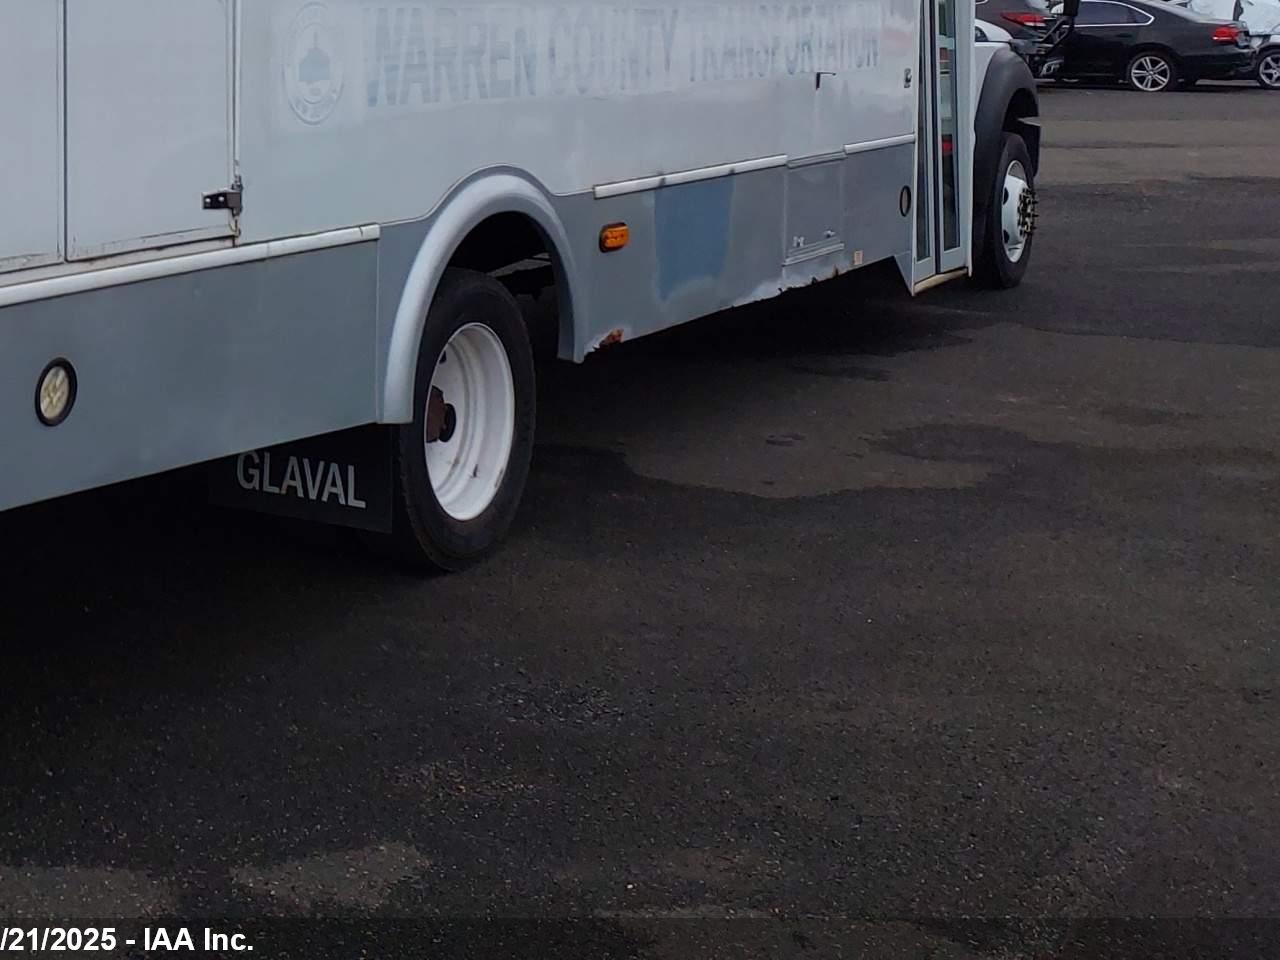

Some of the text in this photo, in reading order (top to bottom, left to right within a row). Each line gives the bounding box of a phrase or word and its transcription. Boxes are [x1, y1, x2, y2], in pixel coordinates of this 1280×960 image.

[366, 6, 537, 107] WARREN
[548, 4, 680, 96] COUNTY
[236, 450, 366, 508] GLAVAL
